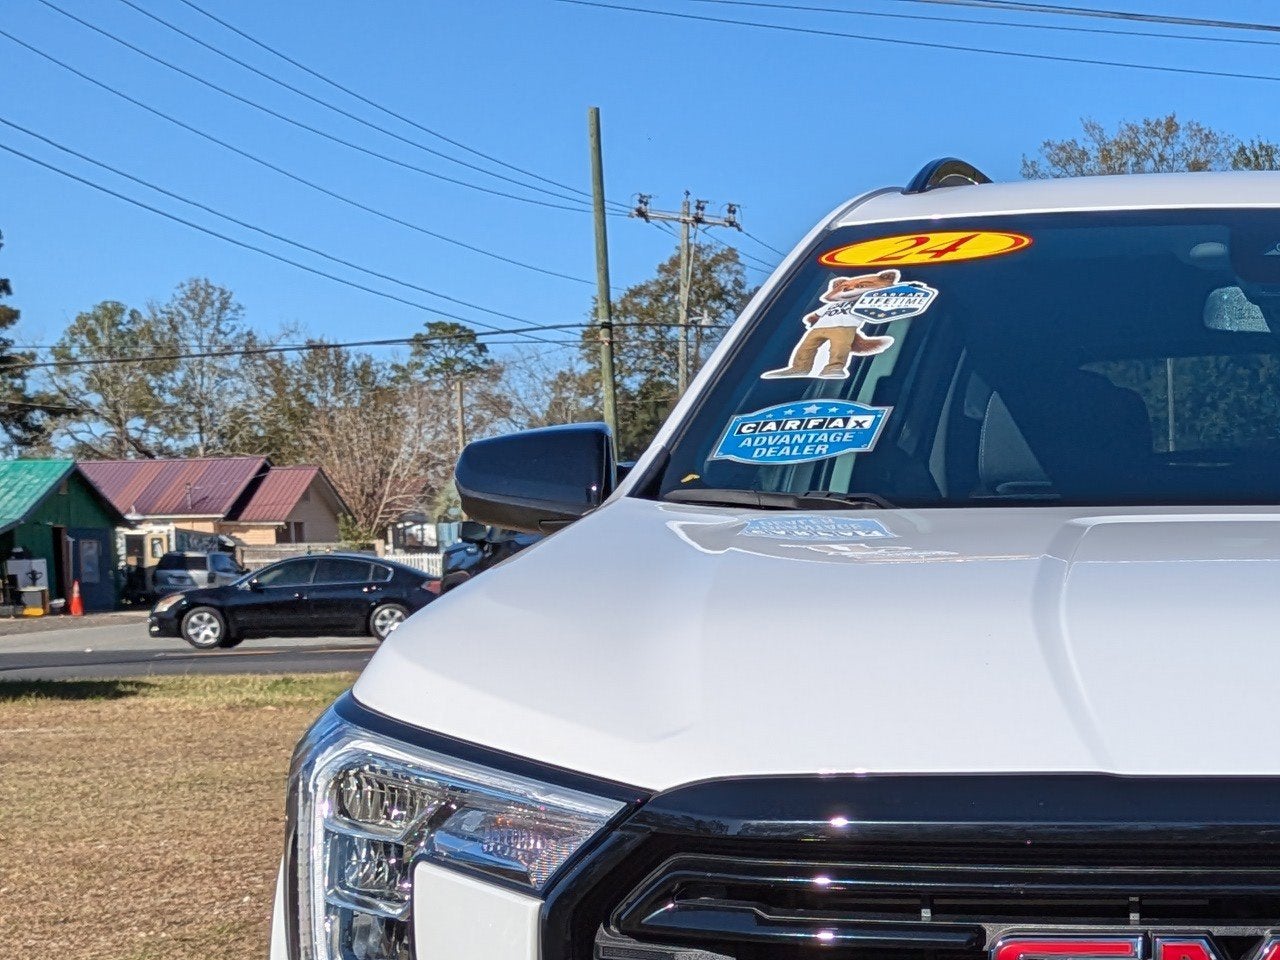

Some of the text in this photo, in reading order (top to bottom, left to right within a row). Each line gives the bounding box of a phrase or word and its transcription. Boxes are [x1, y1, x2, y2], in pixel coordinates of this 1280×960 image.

[866, 233, 982, 264] 24
[822, 308, 849, 317] FOX
[738, 416, 873, 435] CARFAX
[738, 431, 856, 448] ADVANTAGE
[752, 444, 829, 458] DEALER
